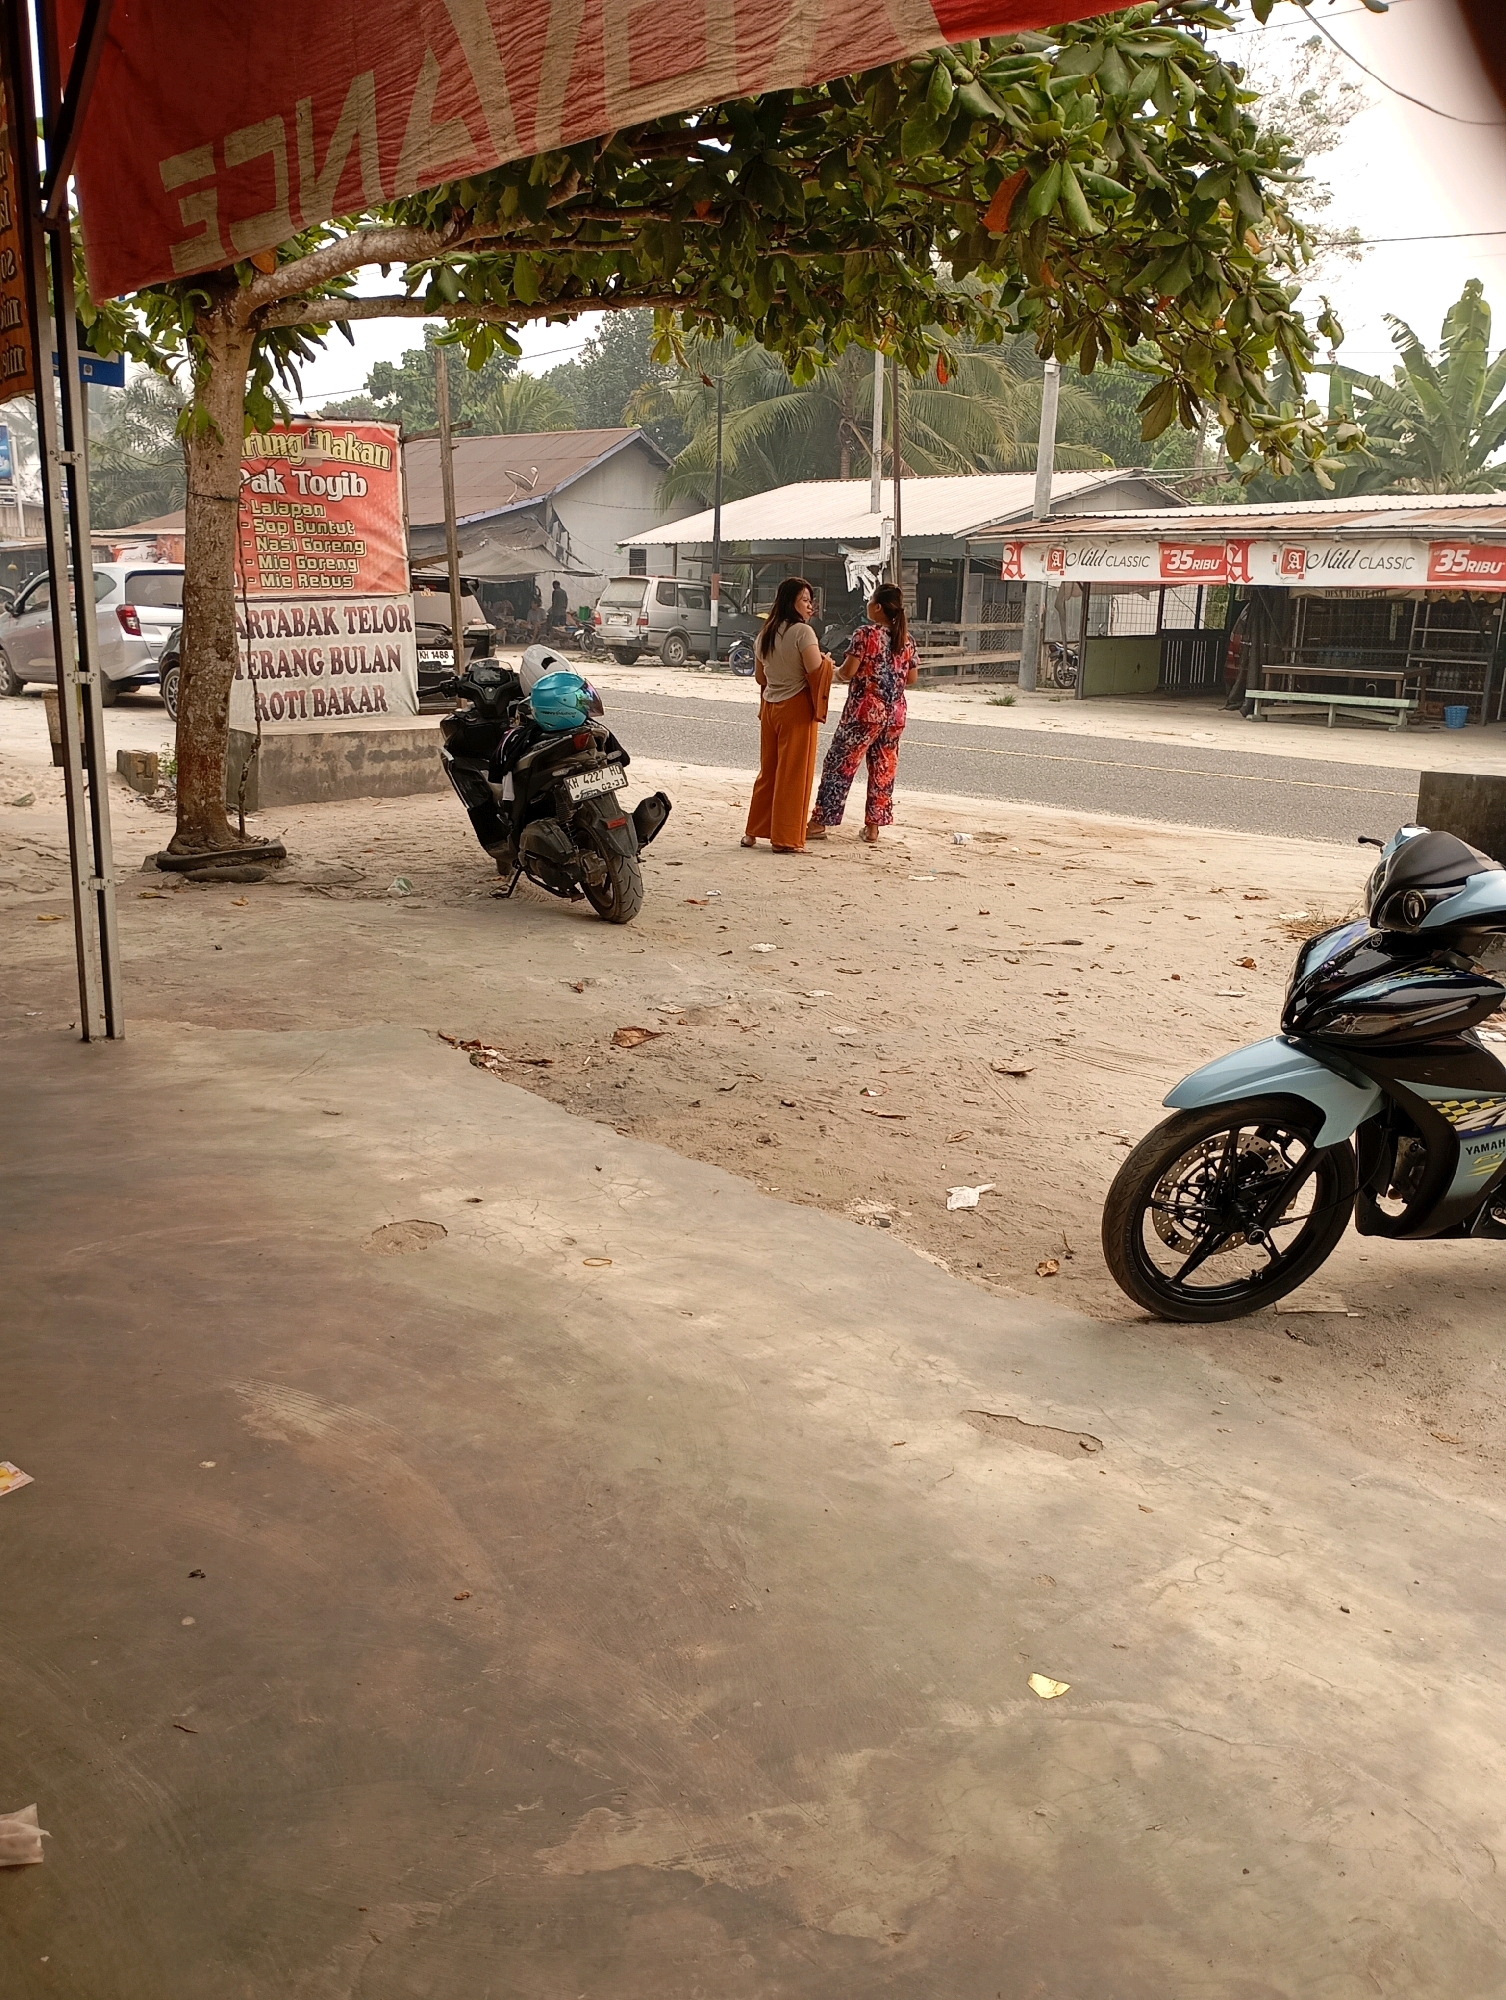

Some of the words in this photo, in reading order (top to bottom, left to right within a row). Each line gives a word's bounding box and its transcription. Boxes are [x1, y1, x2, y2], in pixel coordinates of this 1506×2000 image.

[291, 469, 368, 502] Toyib
[251, 500, 326, 518] Lalapan
[254, 519, 289, 537] Sop
[293, 520, 356, 536] Buntut
[256, 537, 298, 553] Nasi
[302, 538, 367, 557] Goreng
[1066, 546, 1108, 568] Mild
[1105, 556, 1150, 568] CLASSIC
[258, 555, 292, 571] Mie
[296, 556, 360, 574] Goreng
[1306, 547, 1361, 570] Mild
[1359, 556, 1416, 570] CLASSIC
[260, 573, 295, 590] Mie
[297, 573, 355, 590] Rebus
[235, 606, 340, 640] ARTABAK
[343, 604, 413, 636] TELOR
[329, 644, 402, 676] BULAN
[418, 651, 429, 660] KH
[431, 650, 450, 660] 1488
[255, 690, 308, 721] ROTI
[312, 684, 388, 717] BAKAR
[565, 777, 580, 791] KH
[583, 769, 604, 785] 4227
